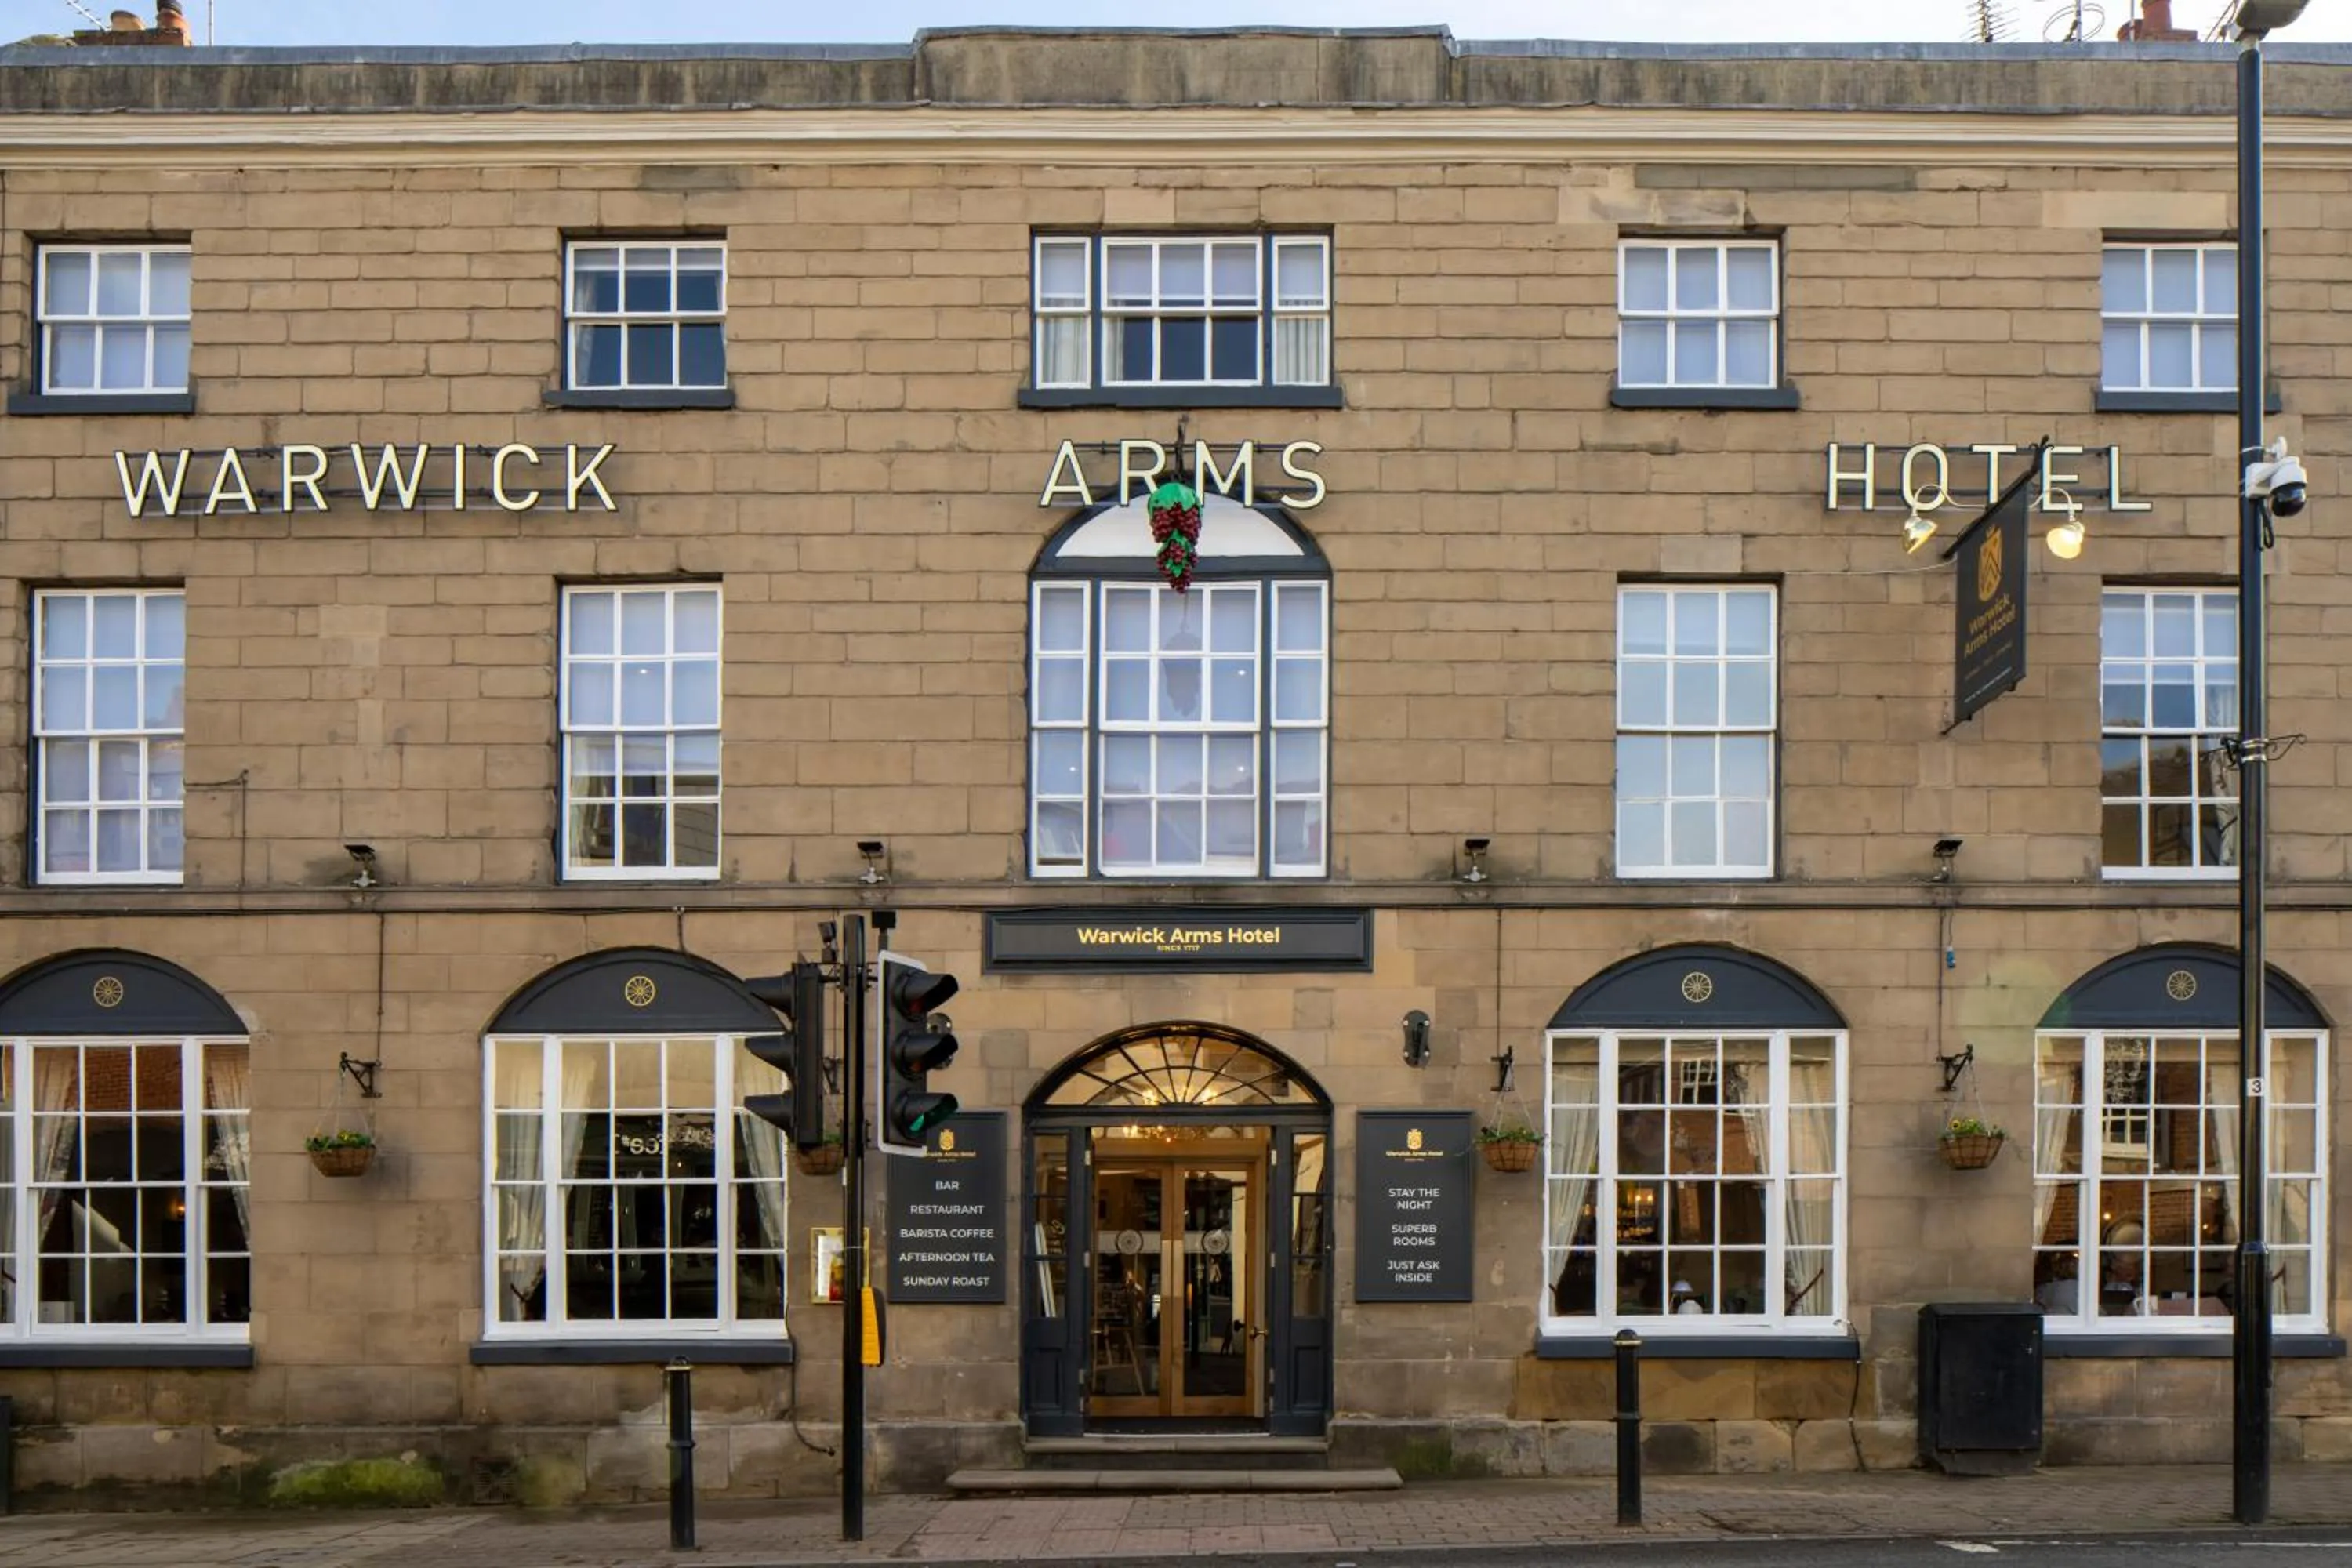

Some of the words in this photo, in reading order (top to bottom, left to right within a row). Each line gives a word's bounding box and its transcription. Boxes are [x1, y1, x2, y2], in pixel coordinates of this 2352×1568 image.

[114, 442, 618, 517] WARWICK
[1038, 439, 1327, 510] ARMS
[1826, 441, 2153, 512] HOTEL
[1969, 593, 2010, 636] Warwick
[1964, 630, 1989, 659] Arms
[1989, 602, 2016, 637] Hotel
[1077, 926, 1165, 944] Warwick
[1169, 927, 1223, 944] Arms
[1228, 927, 1280, 944] Hotel
[2252, 1080, 2262, 1094] 3
[935, 1181, 960, 1190] BAR
[1388, 1188, 1415, 1197] STAY
[1417, 1188, 1440, 1197] THE
[910, 1205, 985, 1214] RESTAURANT
[1396, 1200, 1432, 1210] NIGHT
[900, 1229, 948, 1238] BARISTA
[949, 1229, 994, 1238] COFFEE
[1392, 1224, 1437, 1233] SUPERB
[1393, 1236, 1436, 1246] ROOMS
[899, 1252, 970, 1262] AFTERNOON
[972, 1252, 995, 1262] TEA
[1387, 1261, 1415, 1270] JUST
[1417, 1261, 1440, 1270] ASK
[903, 1276, 950, 1287] SUNDAY
[952, 1276, 990, 1287] ROAST
[1395, 1273, 1432, 1283] INSIDE
